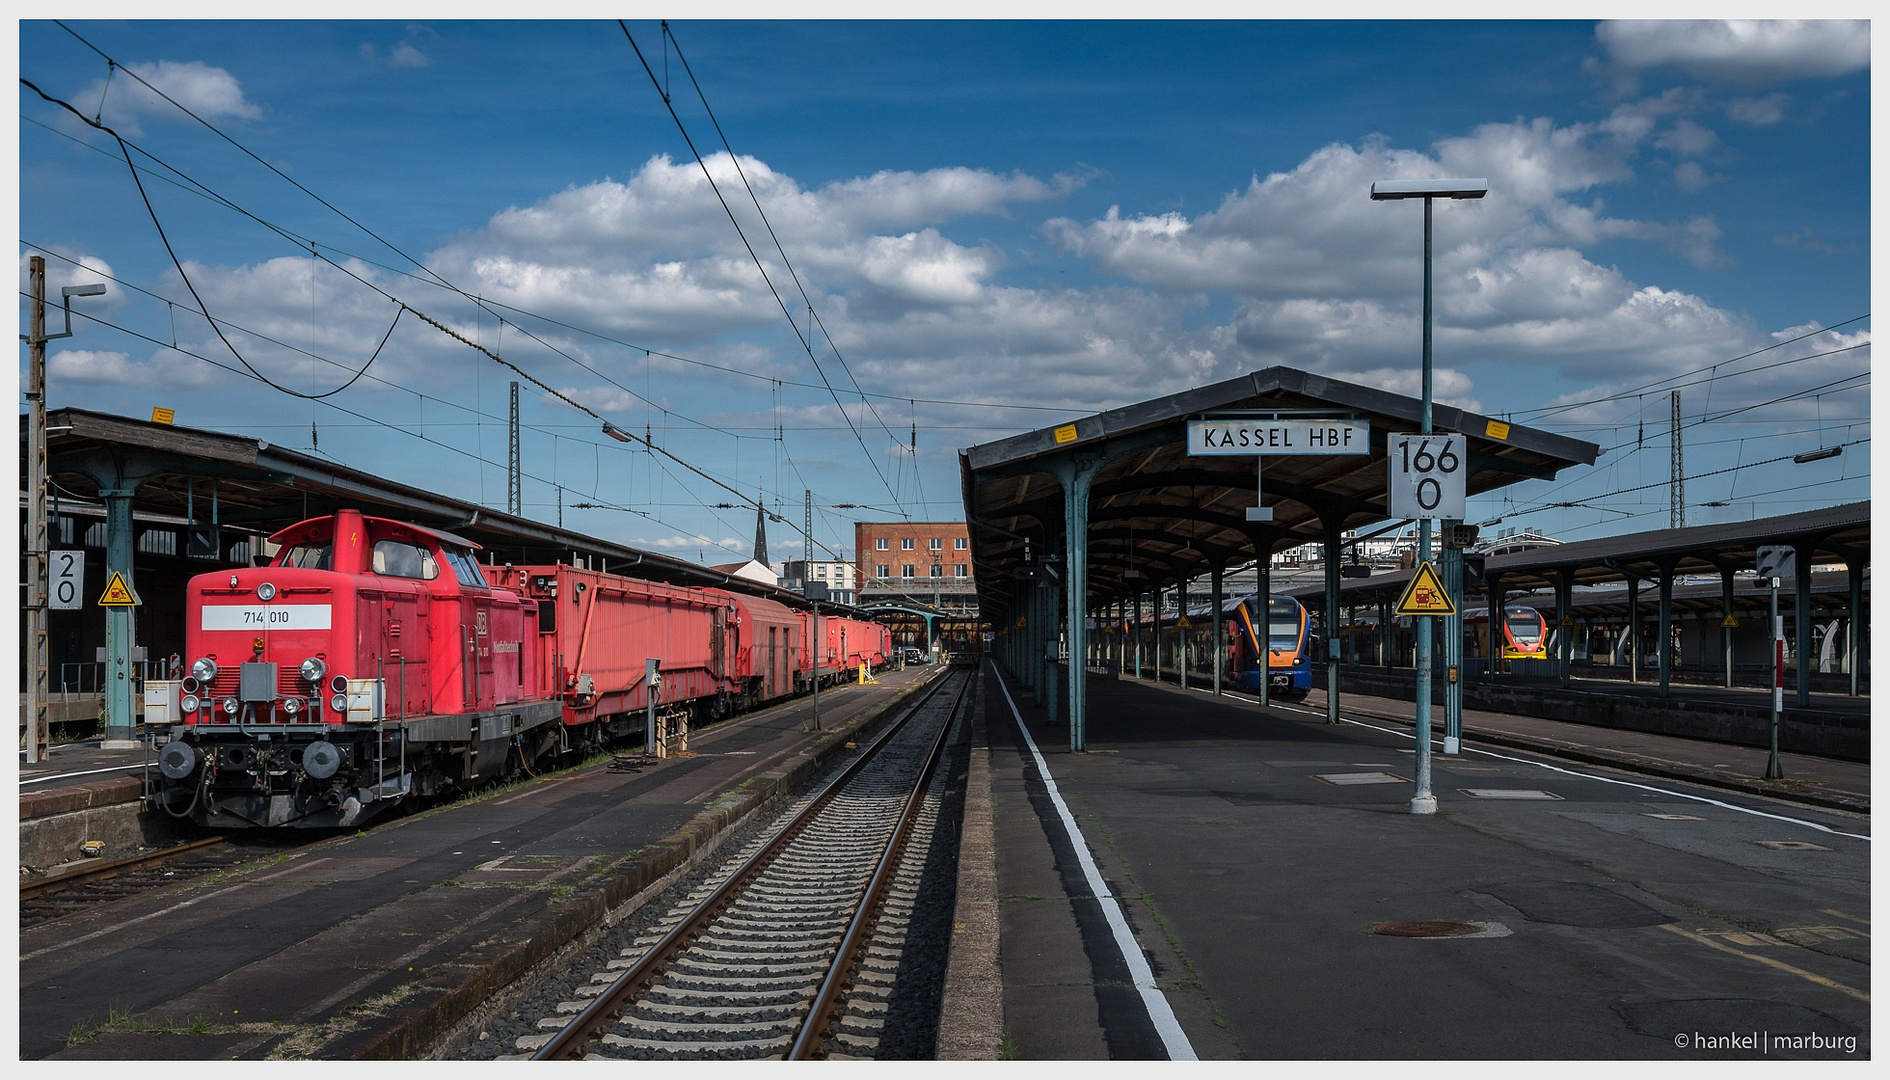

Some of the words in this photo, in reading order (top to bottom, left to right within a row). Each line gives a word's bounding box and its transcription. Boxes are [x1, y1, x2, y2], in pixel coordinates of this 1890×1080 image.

[1204, 427, 1293, 447] KASSEL
[1309, 427, 1353, 447] HBF
[1398, 439, 1459, 473] 166
[1416, 477, 1441, 510] 0
[59, 554, 75, 578] 2
[57, 580, 75, 604] 0
[244, 611, 264, 623] 714
[270, 611, 289, 623] 010
